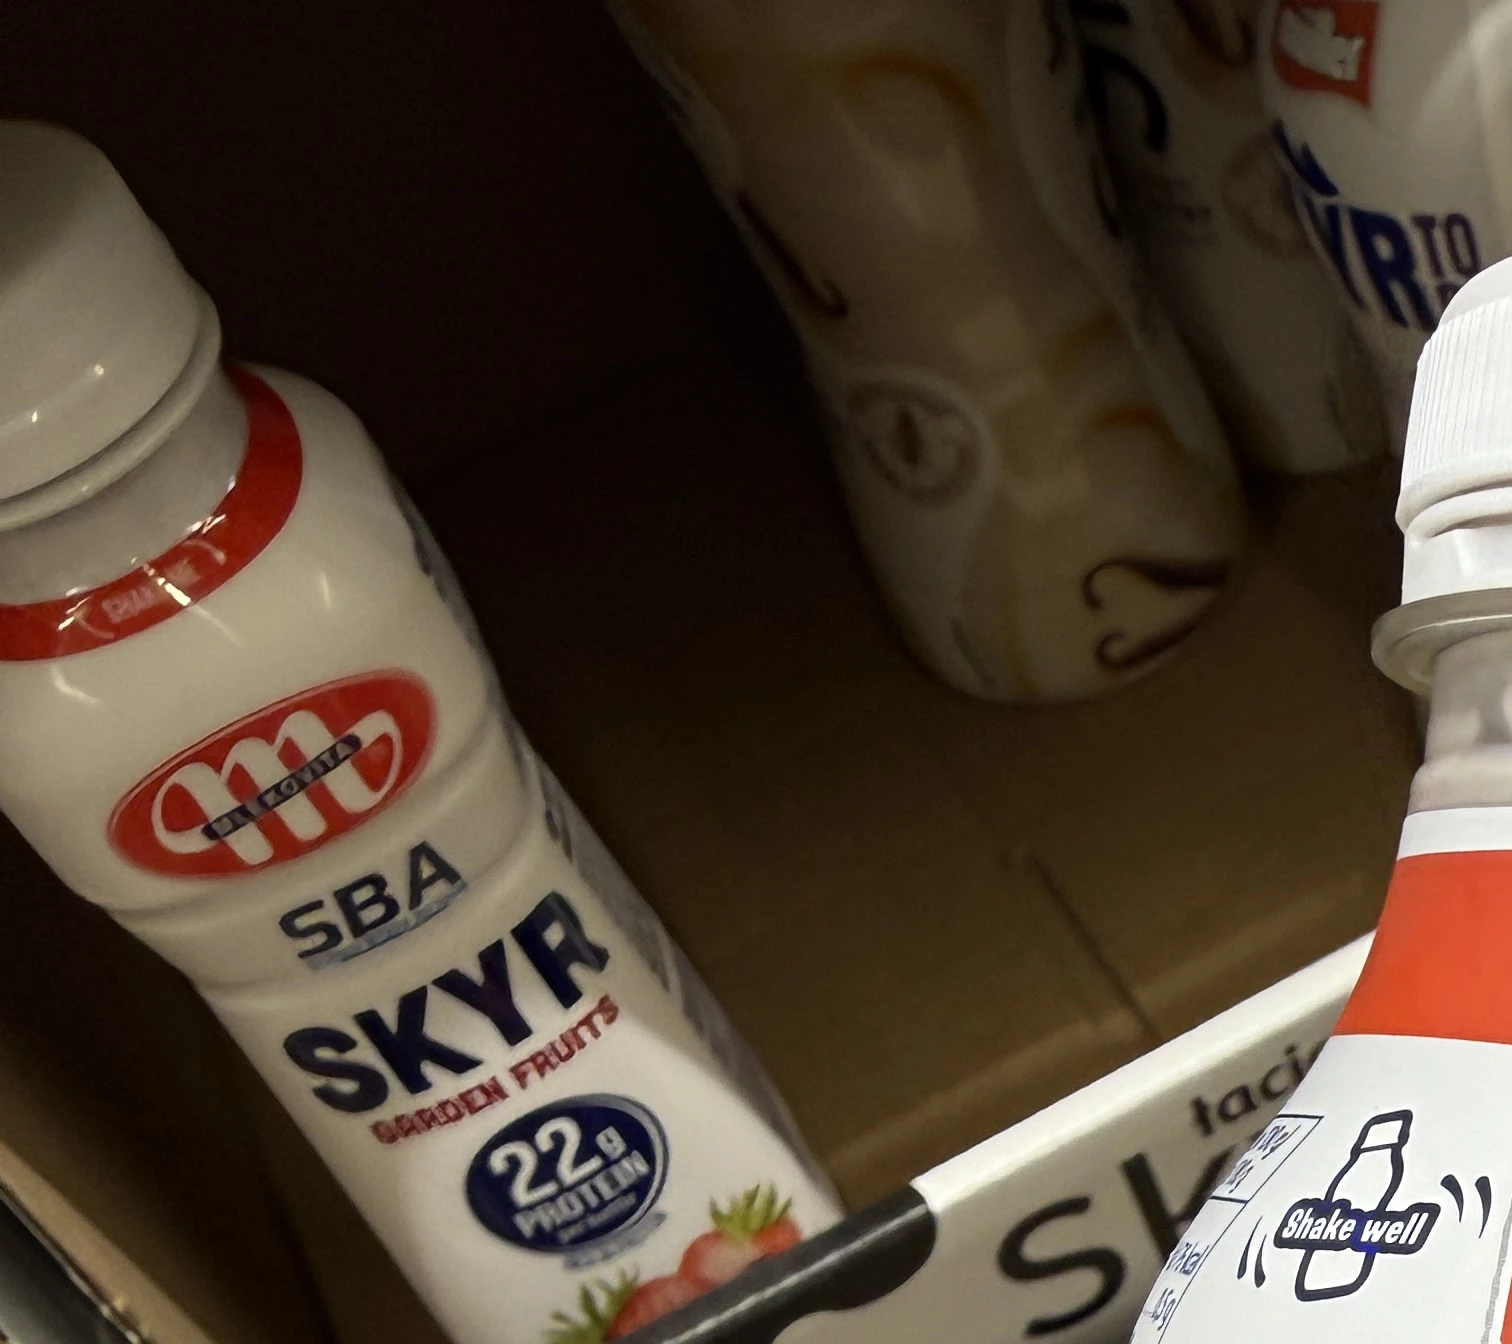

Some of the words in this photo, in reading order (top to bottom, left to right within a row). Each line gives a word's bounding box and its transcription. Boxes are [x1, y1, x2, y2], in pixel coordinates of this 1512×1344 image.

[1410, 212, 1481, 277] TO
[278, 841, 462, 958] SBA
[283, 891, 610, 1113] SKYR
[509, 994, 619, 1089] FRUITS
[512, 1149, 651, 1240] PROTEIN
[1281, 1207, 1357, 1241] Shake
[1360, 1212, 1429, 1245] well
